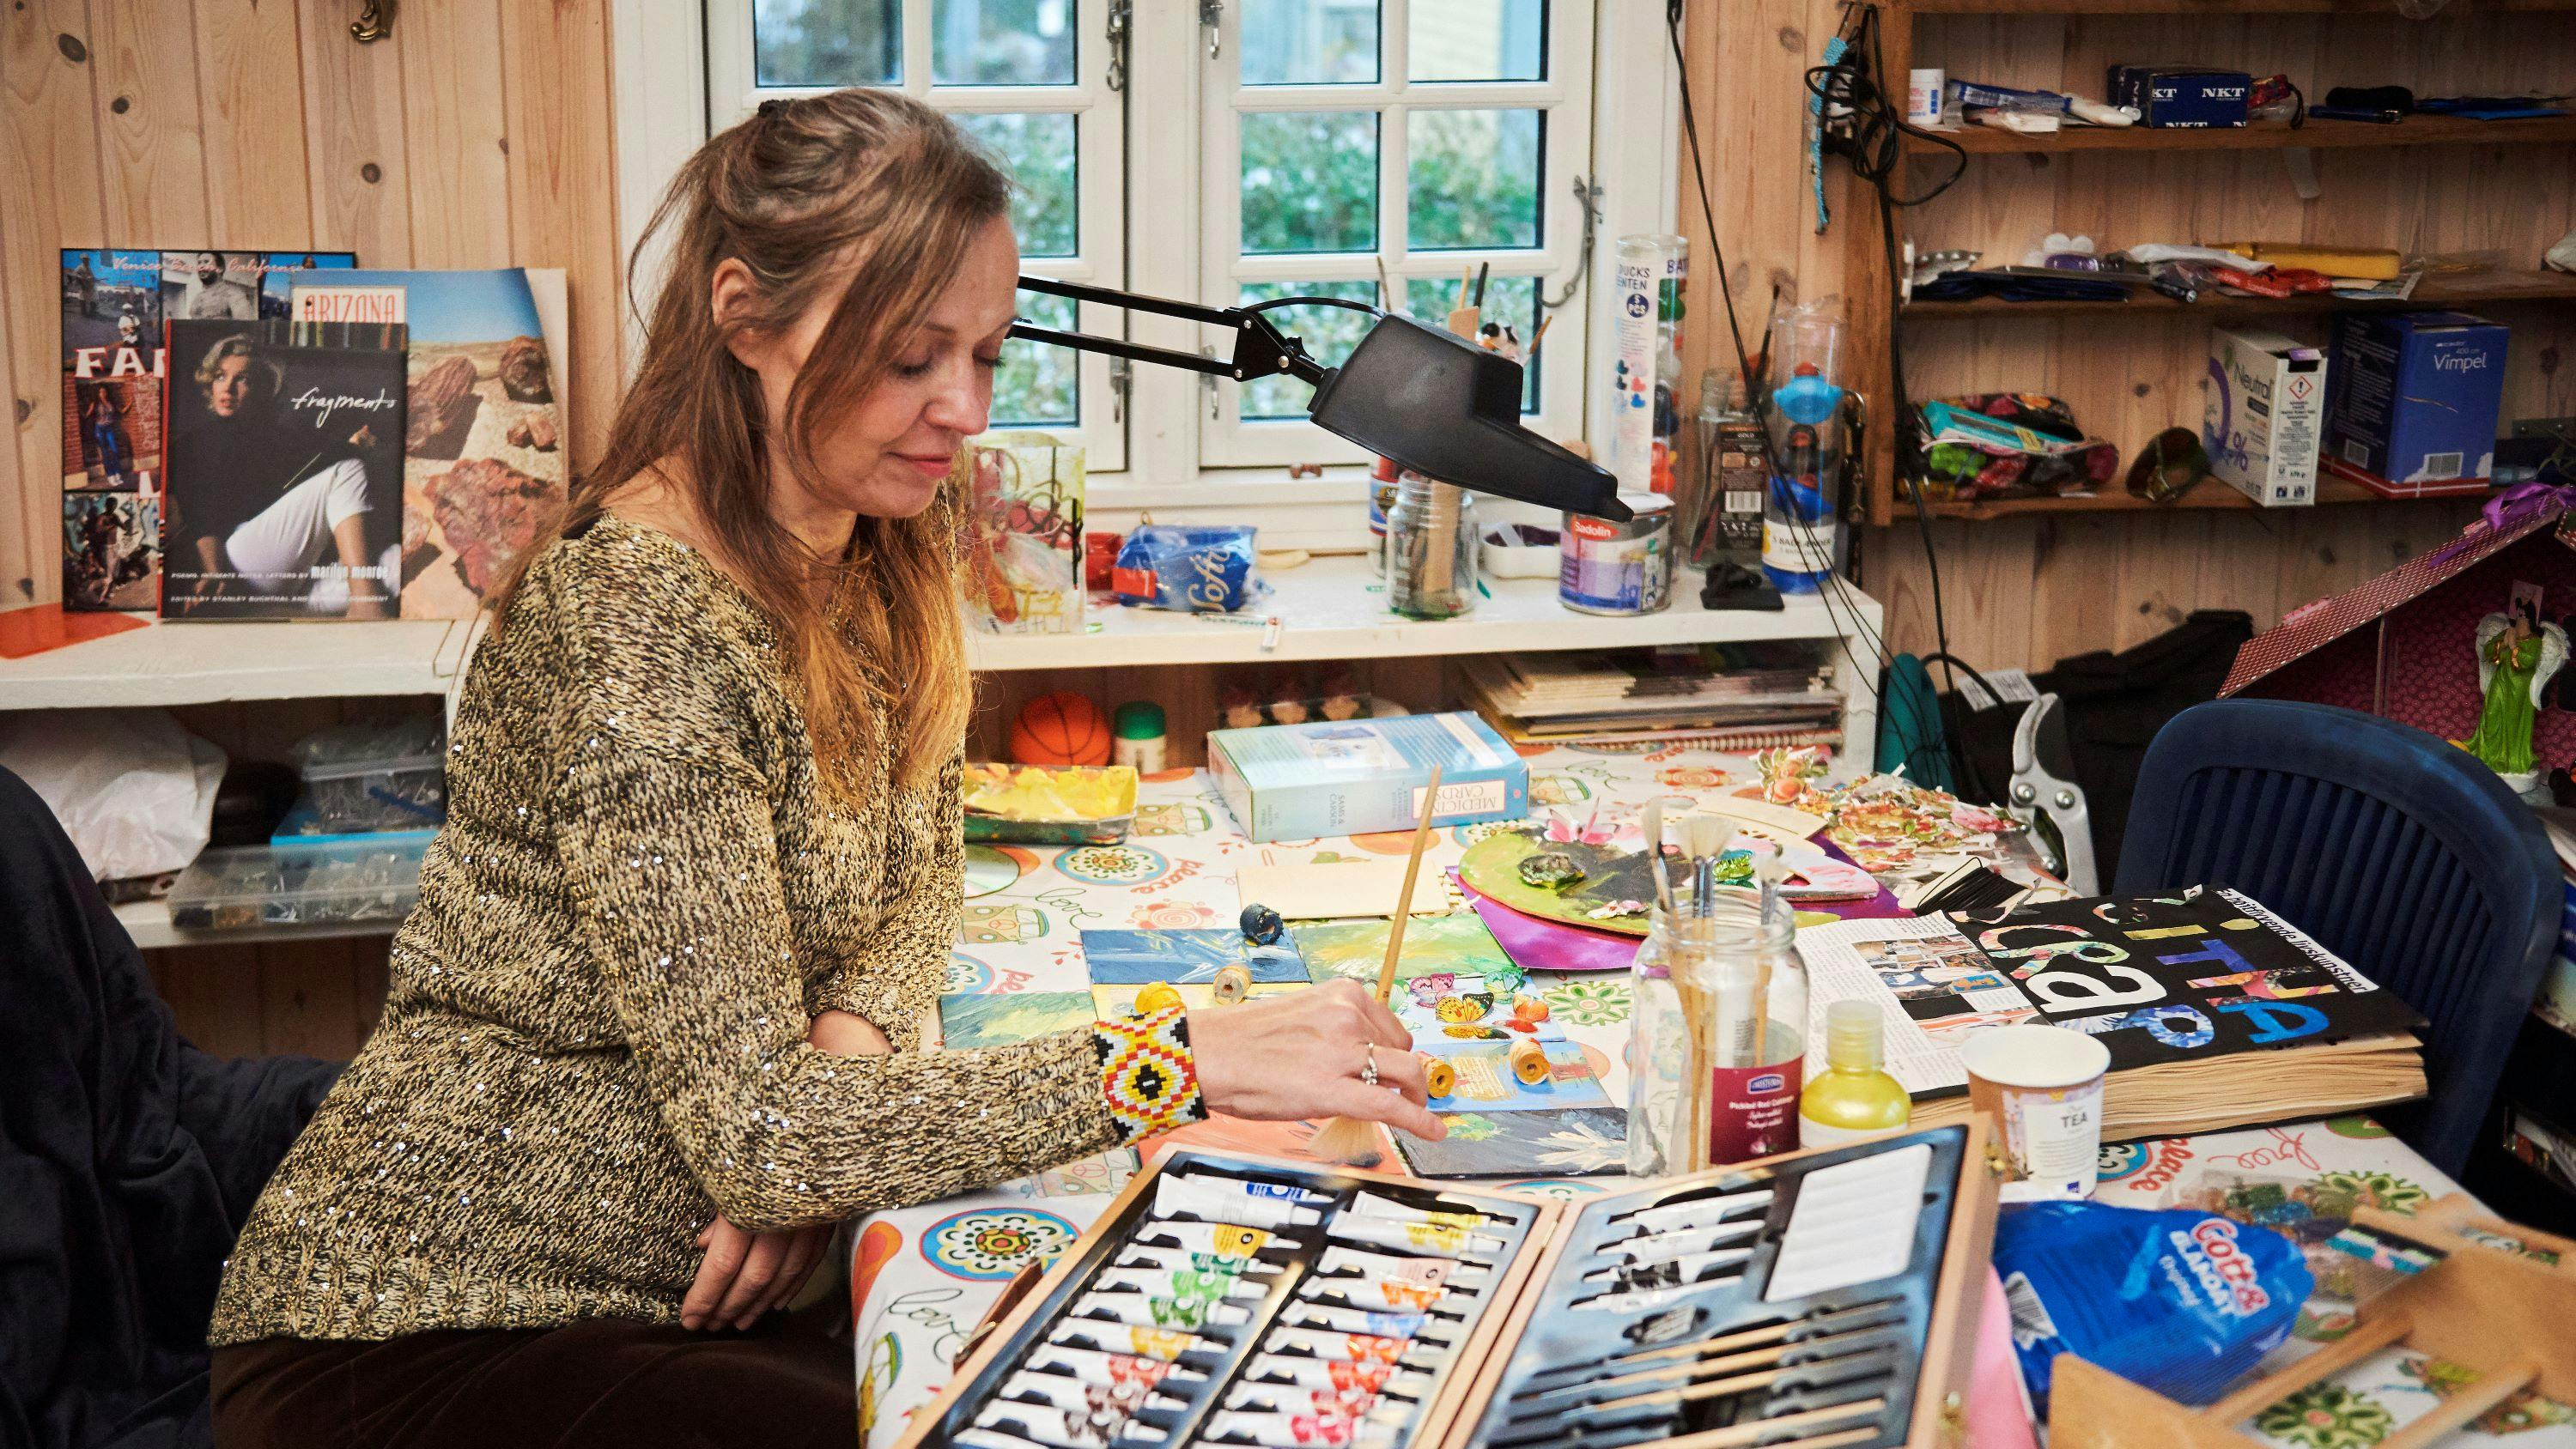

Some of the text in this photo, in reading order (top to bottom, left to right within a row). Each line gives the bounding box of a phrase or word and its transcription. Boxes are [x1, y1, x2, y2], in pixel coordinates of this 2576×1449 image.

[2202, 88, 2245, 98] NKT
[112, 257, 163, 271] Venice
[303, 293, 395, 324] ARIZONA
[2433, 352, 2487, 373] Vimpel
[291, 385, 397, 427] fragments
[1574, 521, 1611, 537] Sadolin
[311, 561, 348, 580] marilyn
[351, 565, 387, 579] monroe
[1427, 797, 1497, 814] MEDICIN
[1035, 888, 1103, 930] love
[2295, 937, 2368, 993] livskunstner
[2062, 1113, 2088, 1128] TEA
